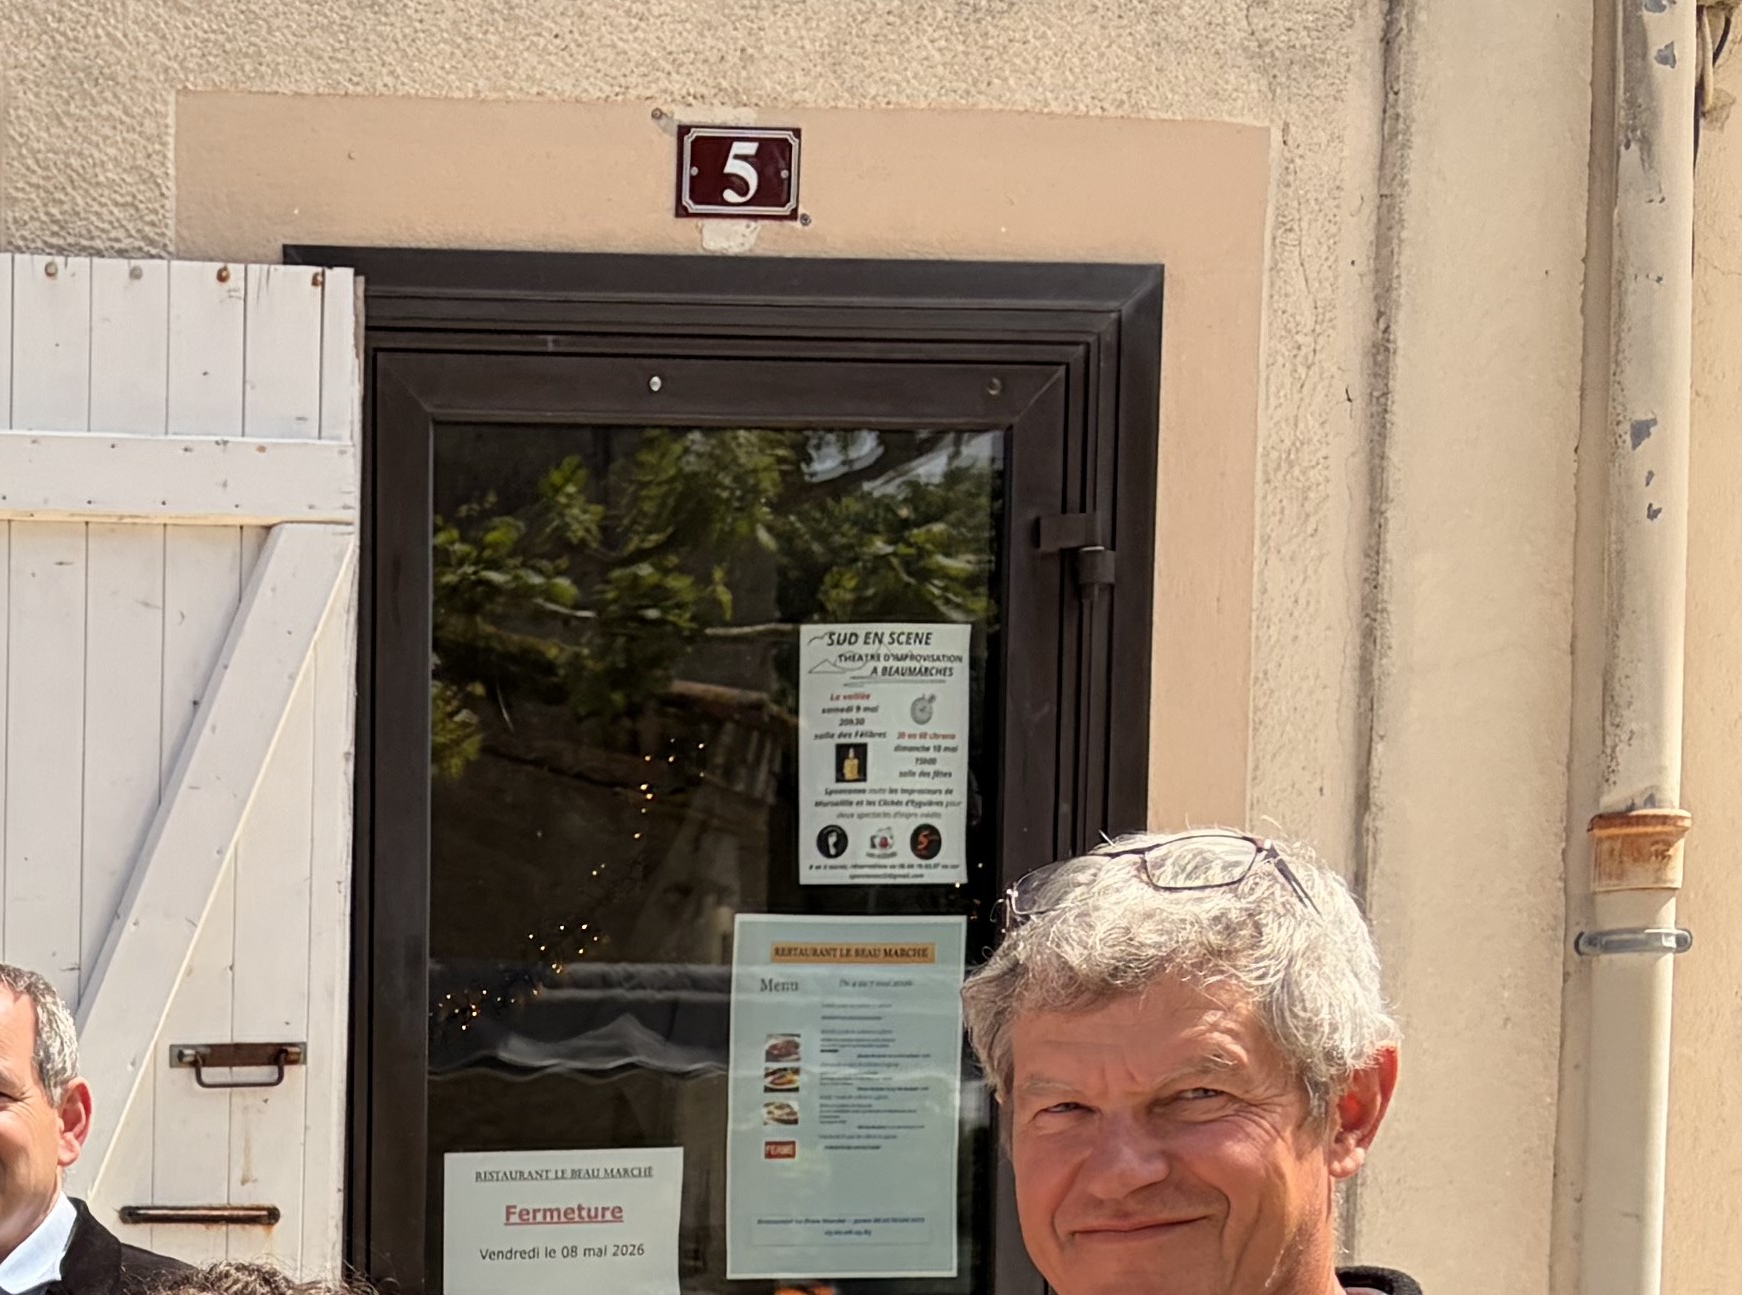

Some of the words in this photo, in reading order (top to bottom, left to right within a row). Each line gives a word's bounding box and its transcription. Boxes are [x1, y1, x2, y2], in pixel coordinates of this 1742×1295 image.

[722, 141, 759, 203] 5
[827, 631, 859, 646] SUD
[863, 631, 884, 645] EN
[887, 631, 932, 646] SCENE
[774, 947, 839, 958] RESTAURANT
[839, 947, 853, 958] LE
[854, 947, 881, 958] BEAU
[759, 978, 799, 993] Menu
[475, 1168, 552, 1183] RESTAURANT
[554, 1169, 567, 1181] LE
[570, 1168, 601, 1181] BEAU
[505, 1203, 624, 1224] Fermeture
[479, 1246, 540, 1261] Vendredi
[545, 1246, 557, 1259] le
[561, 1245, 579, 1258] 08
[583, 1245, 607, 1258] mai
[612, 1243, 645, 1257] 2026
